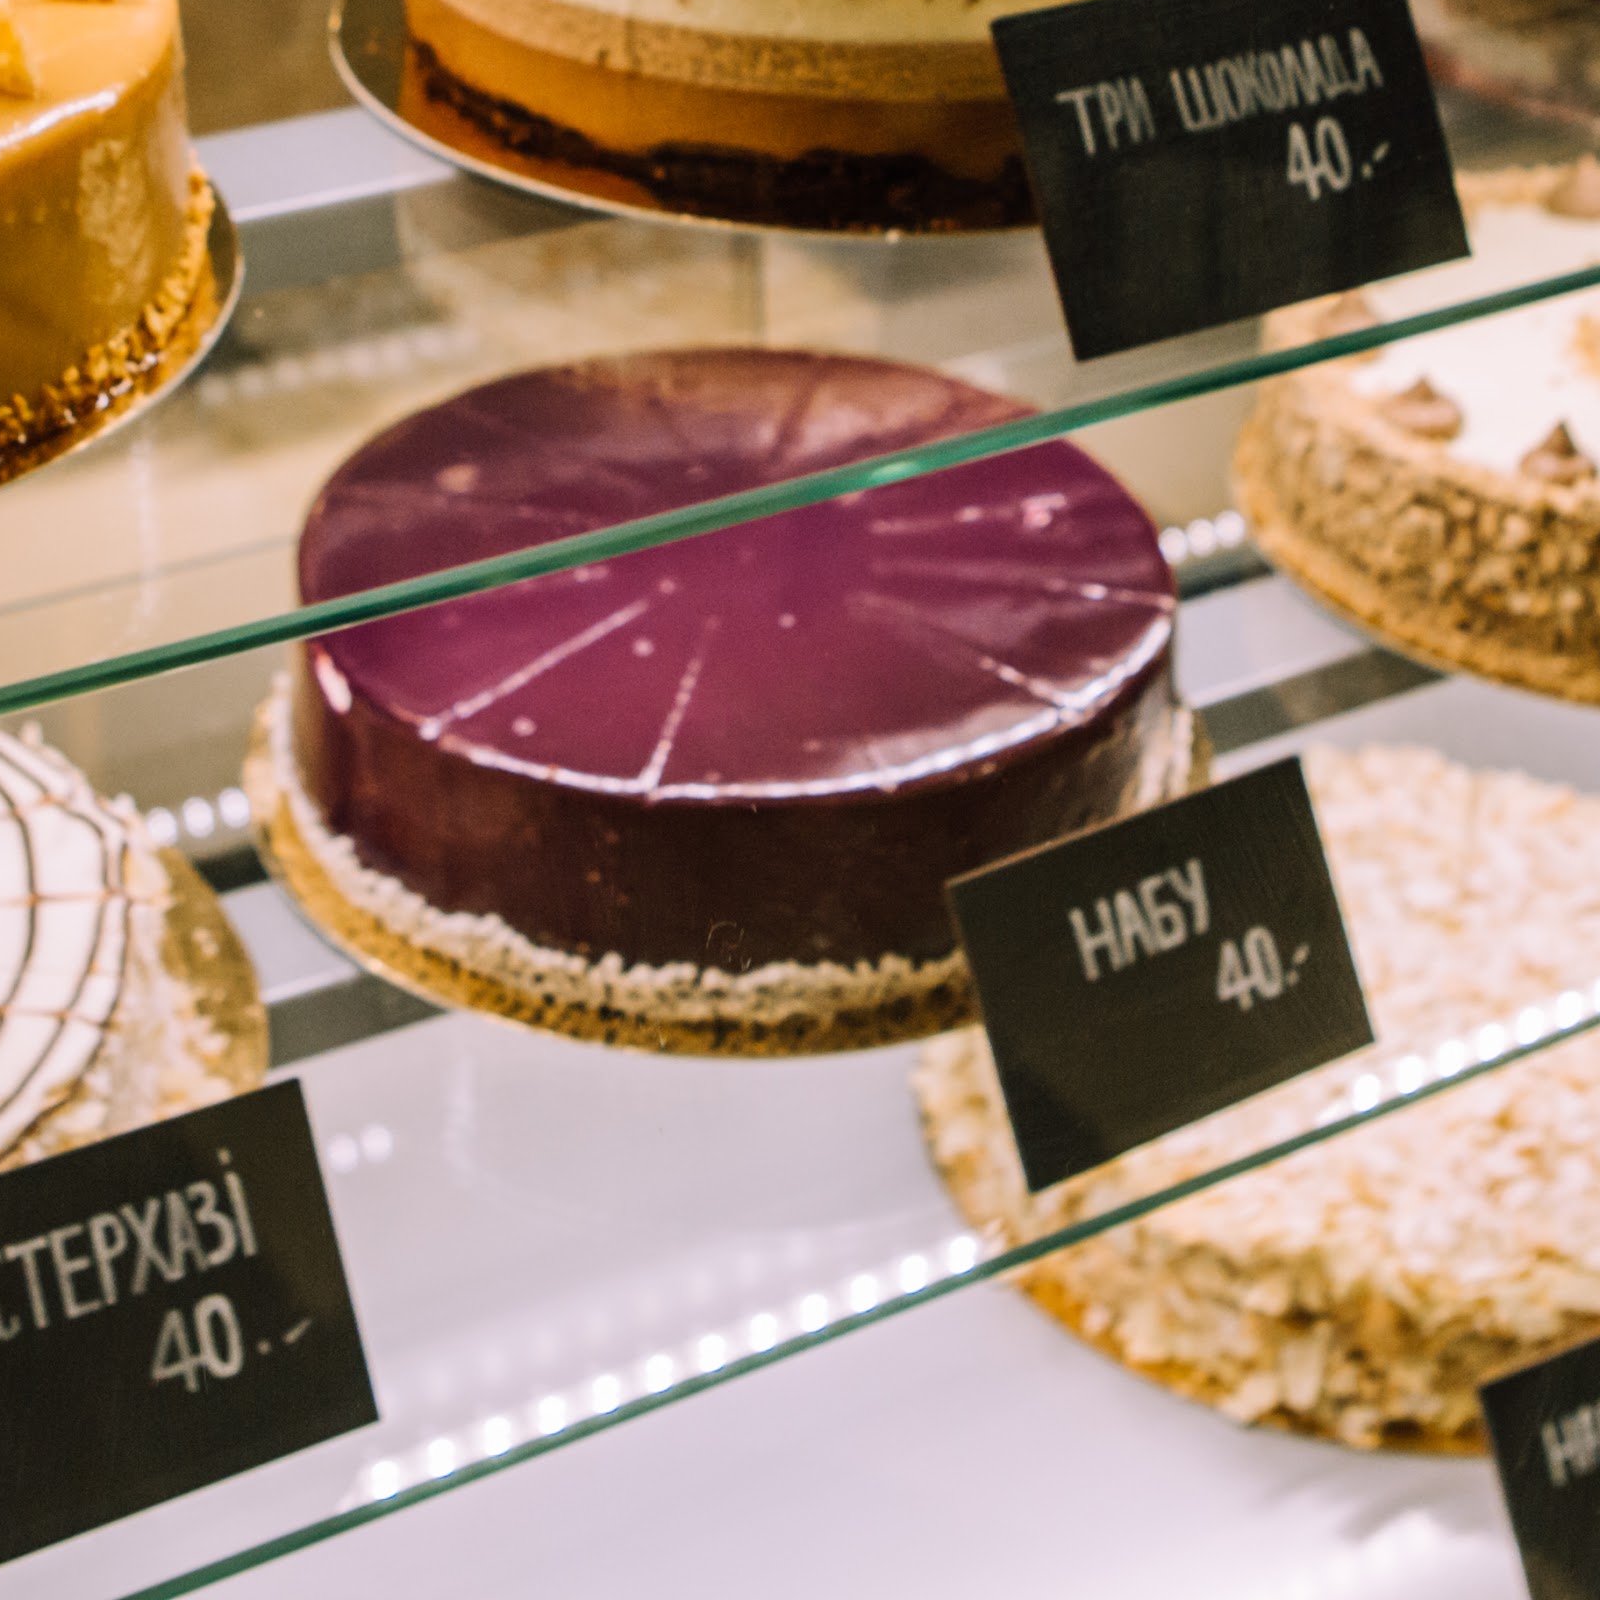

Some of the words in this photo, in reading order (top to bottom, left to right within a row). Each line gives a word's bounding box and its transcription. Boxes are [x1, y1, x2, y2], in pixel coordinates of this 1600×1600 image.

[1056, 75, 1156, 157] ТРИ
[1169, 27, 1384, 133] ШОКОЛАДА
[1286, 115, 1391, 201] 40.-
[1068, 857, 1211, 982] НАБУ
[1216, 926, 1310, 1011] 40.-
[150, 1293, 312, 1394] 40.-
